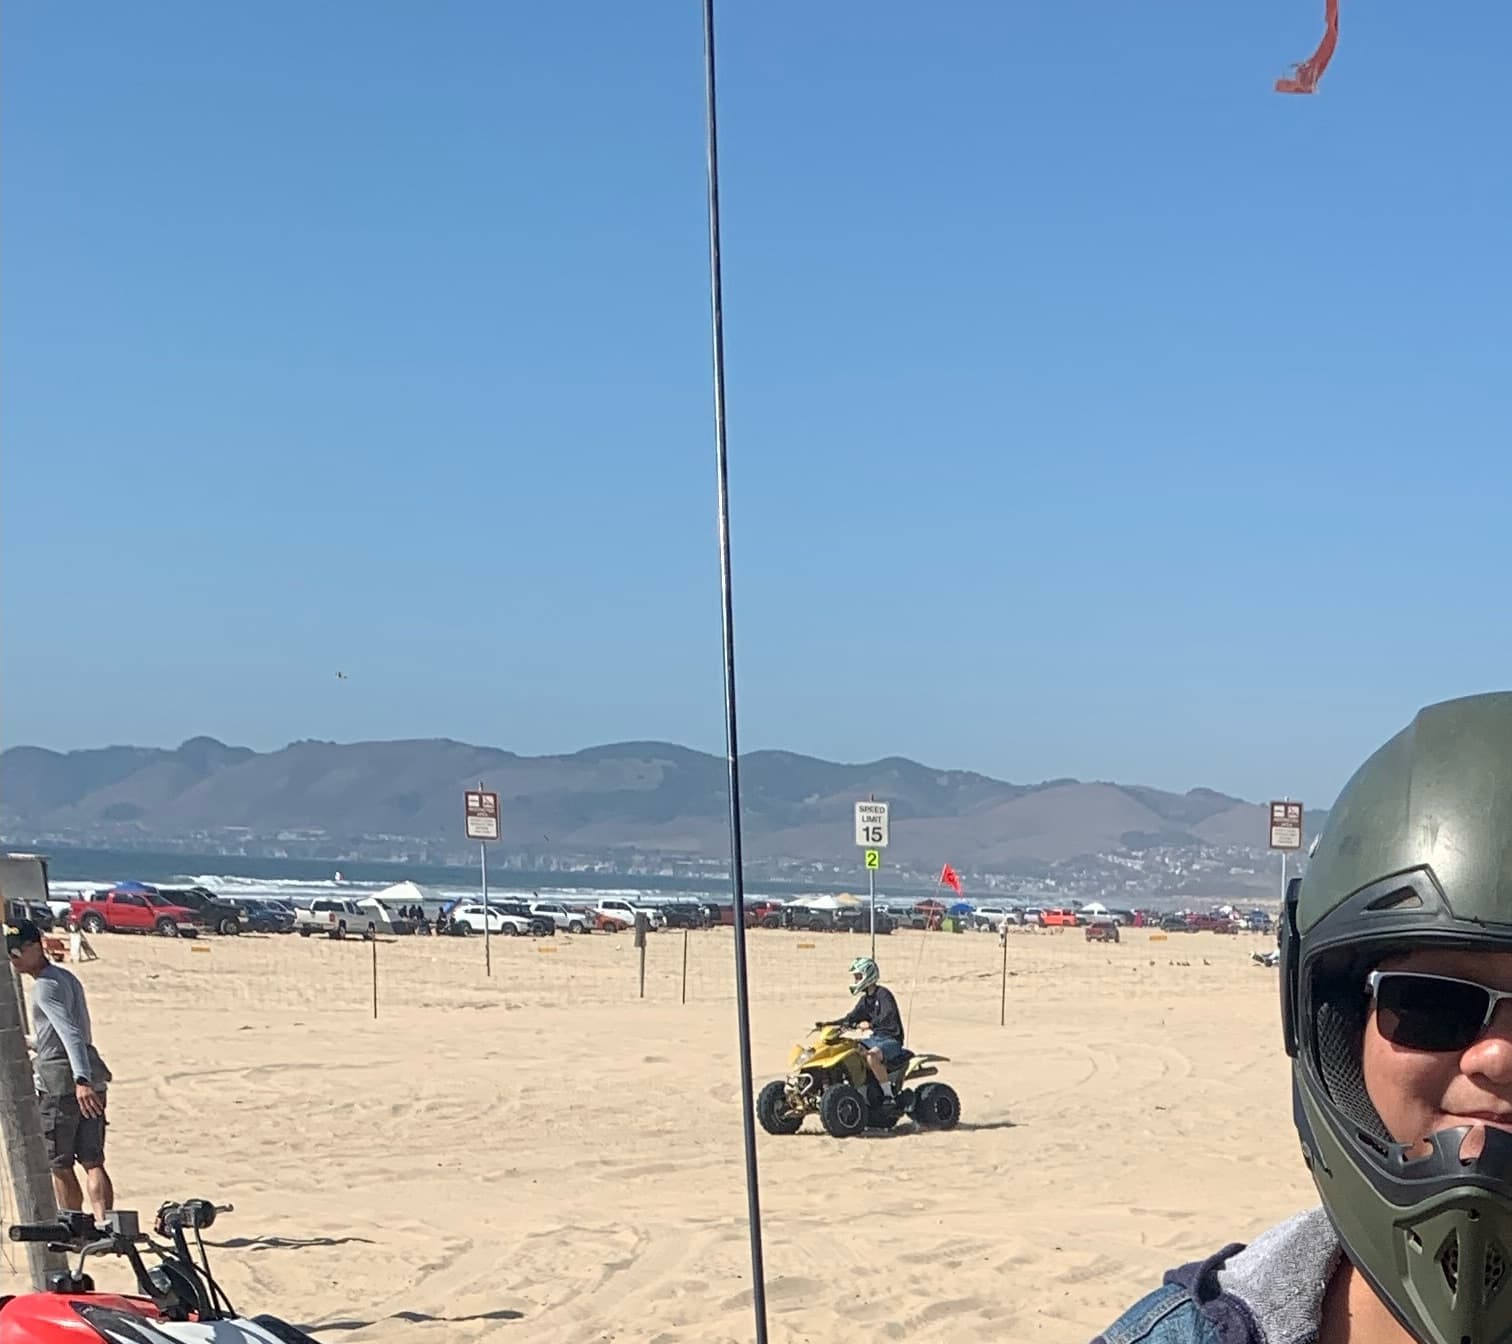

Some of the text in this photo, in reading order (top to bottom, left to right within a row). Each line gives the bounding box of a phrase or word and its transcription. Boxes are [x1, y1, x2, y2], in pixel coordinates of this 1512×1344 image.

[859, 805, 885, 814] SPEED
[862, 815, 881, 823] LIMIT
[862, 826, 882, 842] 15
[867, 852, 877, 867] 2
